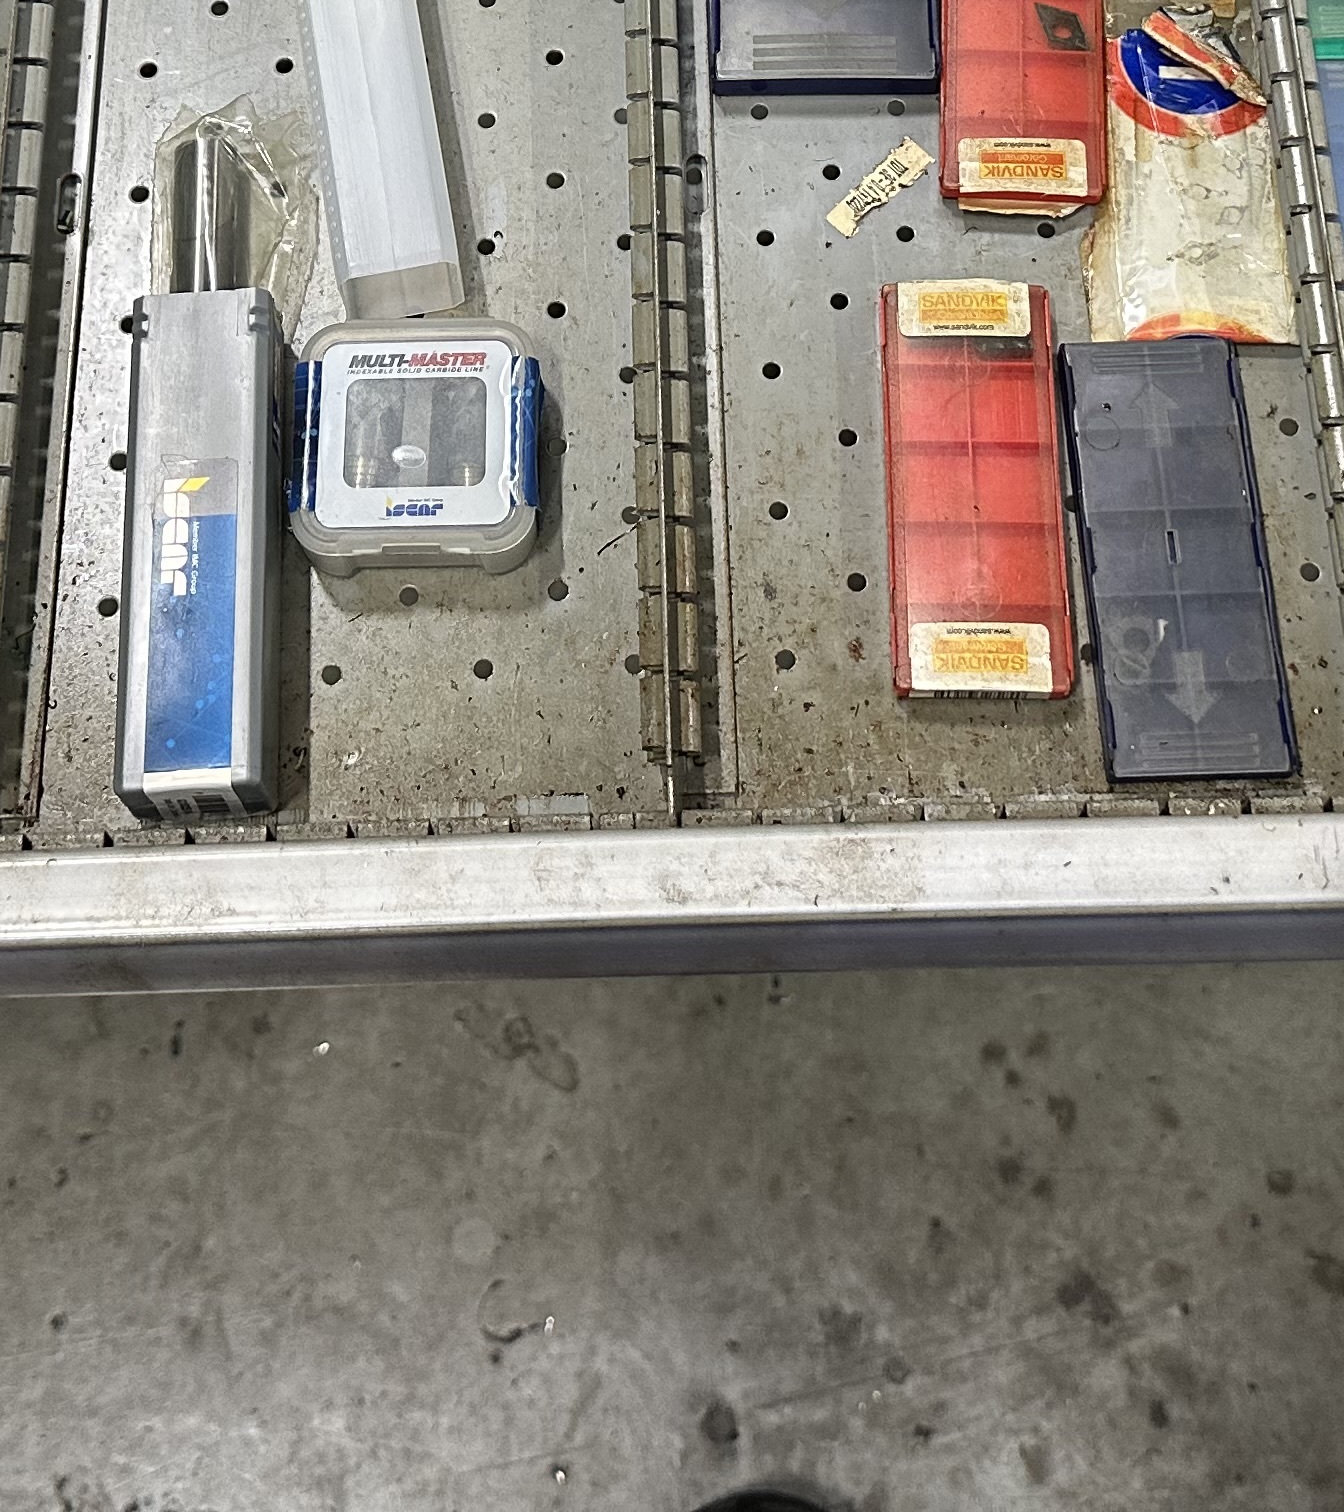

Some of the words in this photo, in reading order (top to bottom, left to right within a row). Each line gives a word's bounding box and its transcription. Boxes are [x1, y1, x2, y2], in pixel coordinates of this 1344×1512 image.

[983, 164, 1063, 177] SANDVIK
[922, 294, 1002, 307] SANDVIK
[348, 352, 486, 368] MULTI-MASTER
[191, 521, 199, 552] Member
[189, 570, 198, 594] Group
[935, 655, 1024, 669] SANDVIK
